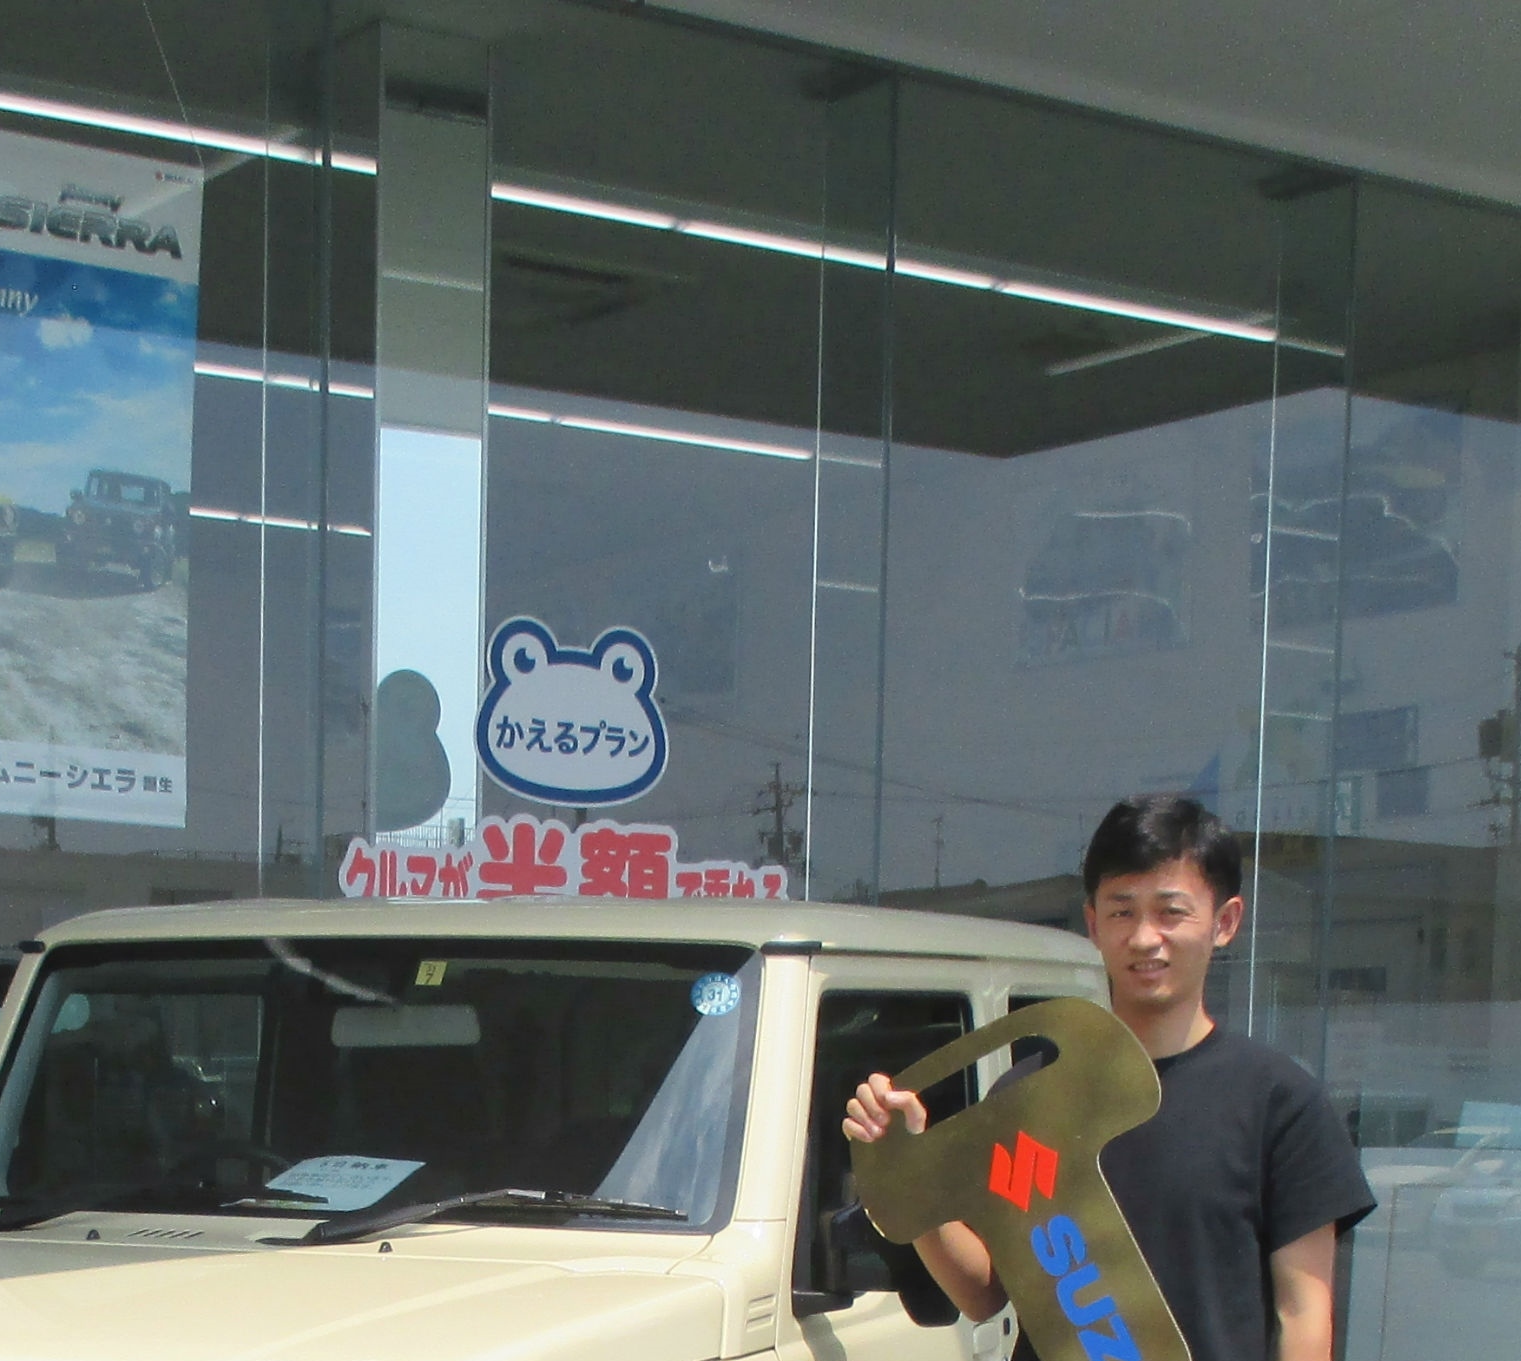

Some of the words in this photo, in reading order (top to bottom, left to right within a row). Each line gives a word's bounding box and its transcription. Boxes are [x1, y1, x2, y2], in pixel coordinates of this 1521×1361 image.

[495, 715, 650, 758] かえるプラン
